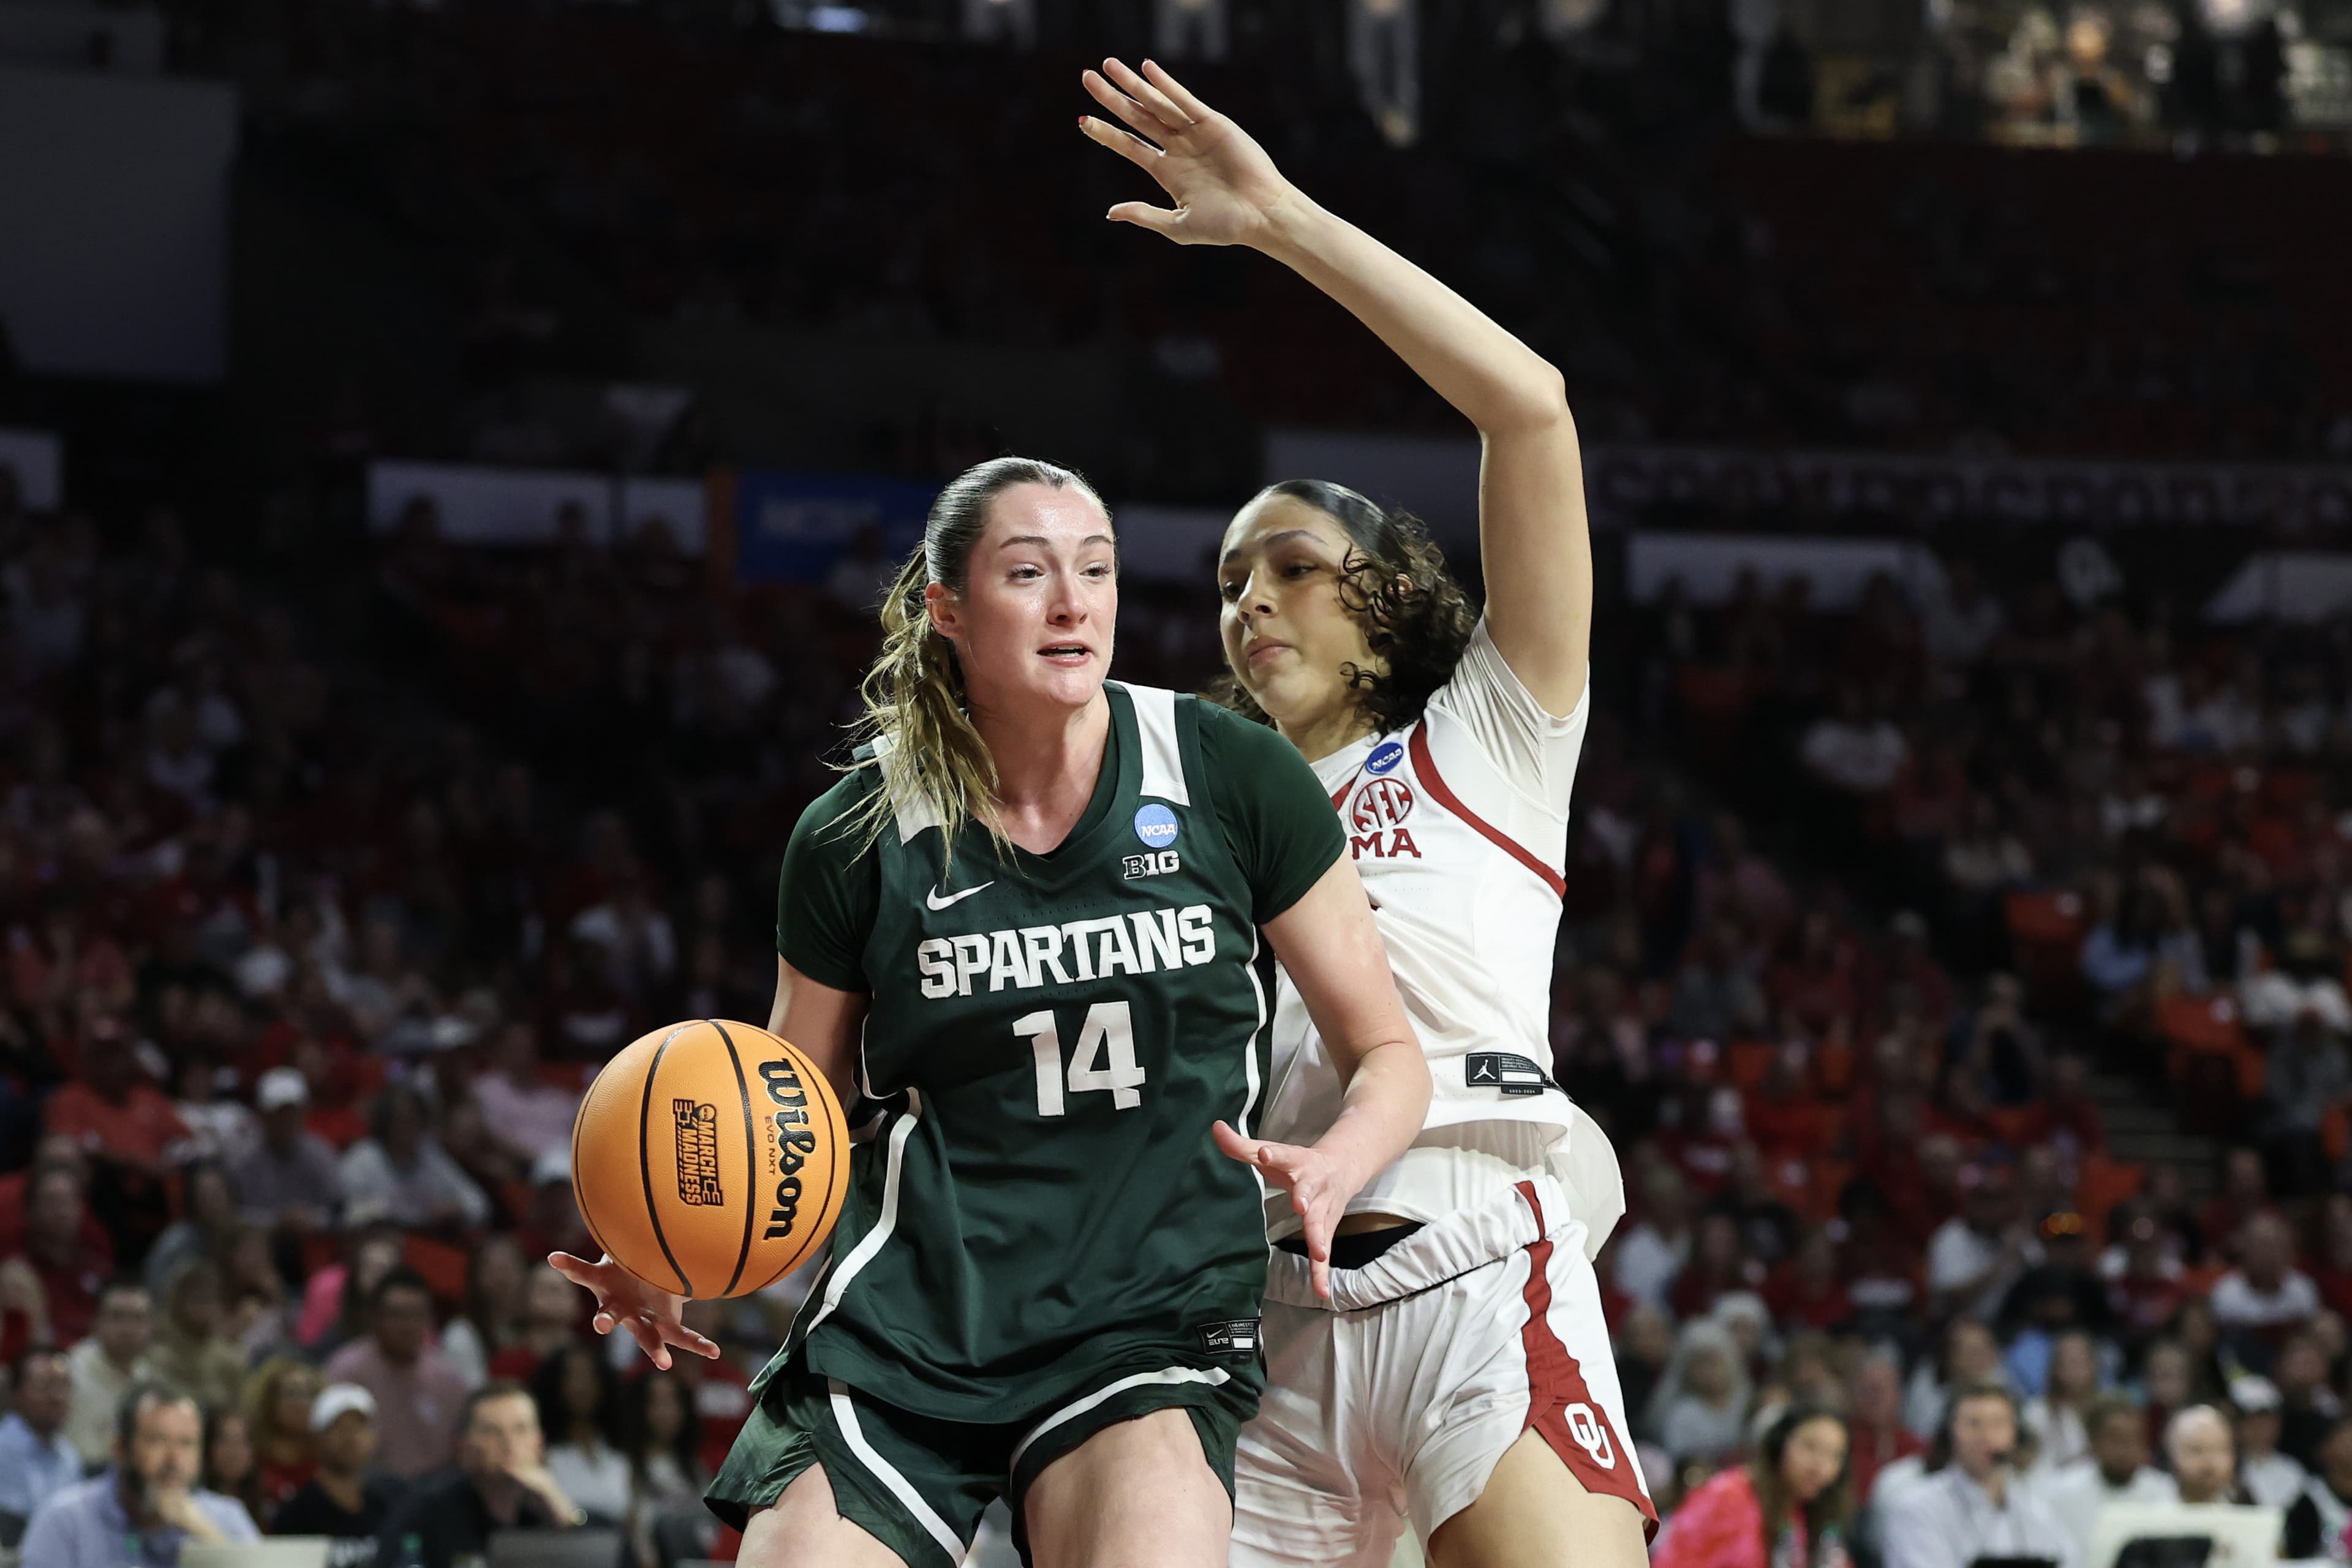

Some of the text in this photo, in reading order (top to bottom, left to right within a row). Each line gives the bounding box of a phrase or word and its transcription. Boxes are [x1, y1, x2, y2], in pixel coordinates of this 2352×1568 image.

[1371, 747, 1403, 770] NCAA
[1141, 823, 1177, 837] NCAA
[1355, 780, 1411, 830] SEC
[918, 903, 1216, 1000] SPARTANS
[1012, 1000, 1146, 1117] 14
[698, 1120, 717, 1178] MARCH
[758, 1057, 816, 1241] Wilson
[764, 1116, 774, 1144] EVO
[681, 1128, 702, 1205] MADNESS
[1564, 1402, 1616, 1470] OU
